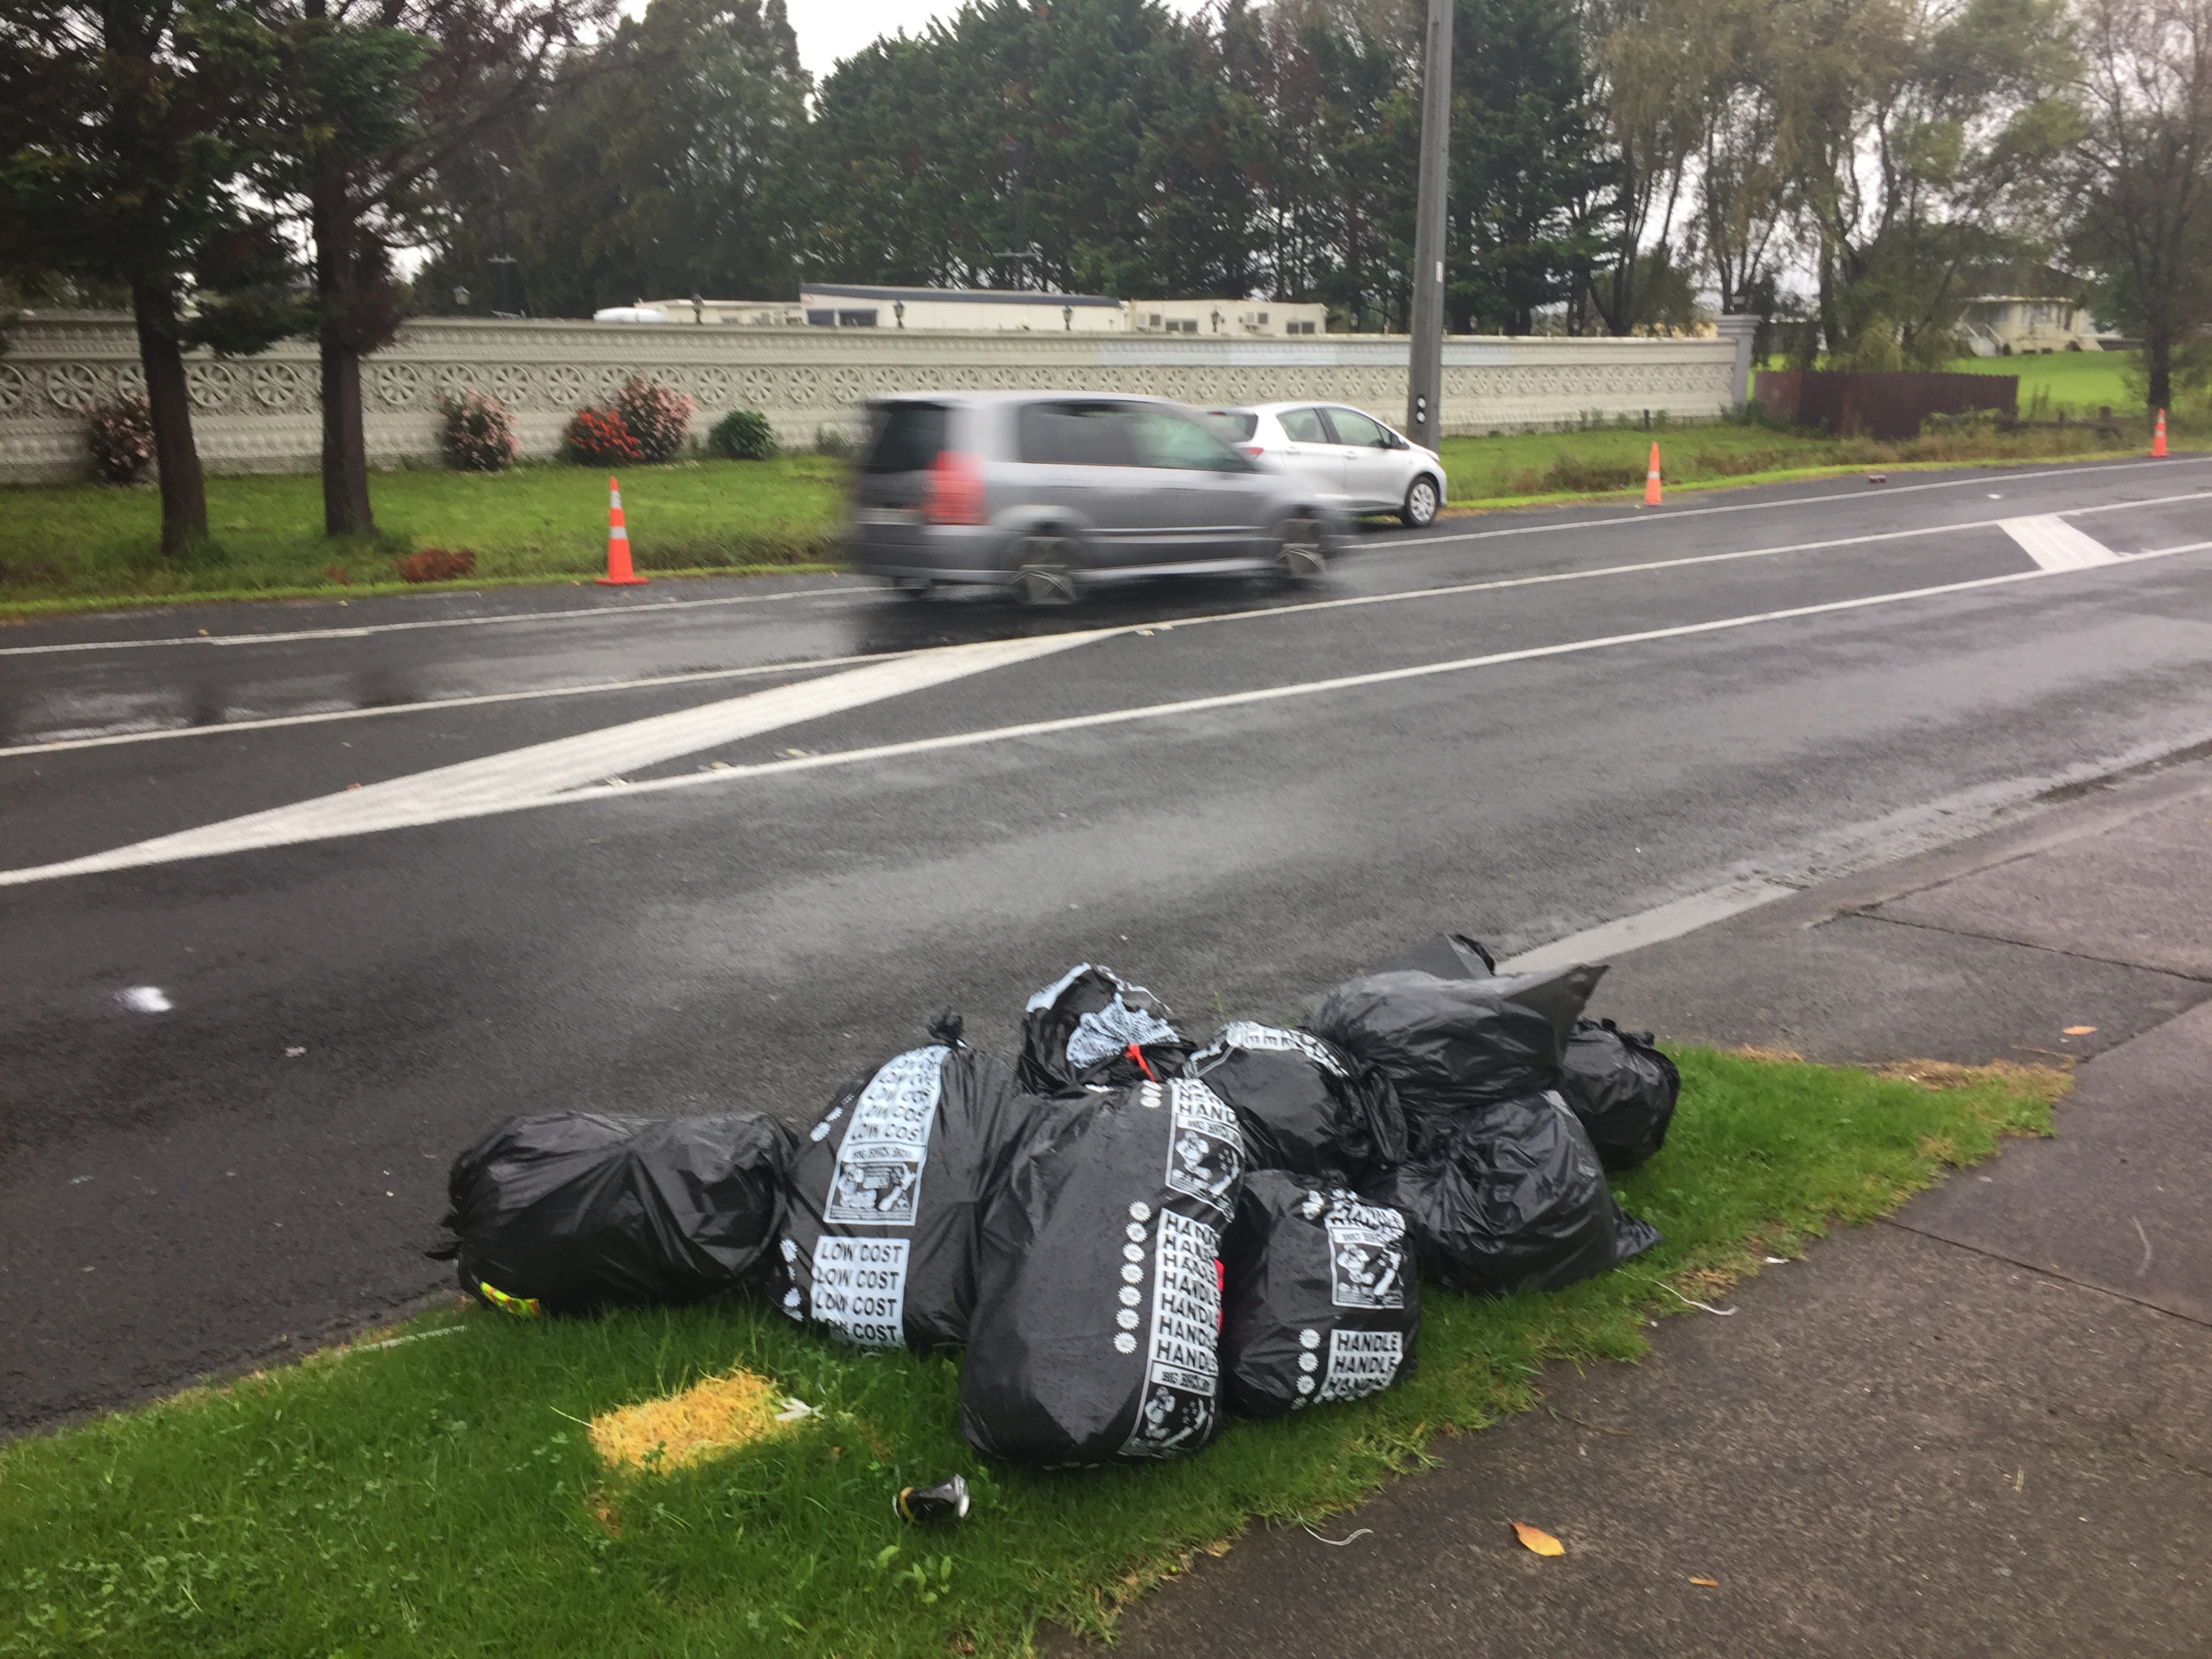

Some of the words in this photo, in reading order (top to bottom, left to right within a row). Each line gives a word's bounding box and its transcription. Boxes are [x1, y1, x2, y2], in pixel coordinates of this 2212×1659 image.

[821, 1242, 856, 1263] LOW
[860, 1244, 903, 1264] COST
[815, 1267, 853, 1288] LOW
[857, 1269, 900, 1290] COST
[815, 1290, 850, 1313] LOW
[853, 1296, 897, 1318] COST
[853, 1322, 898, 1343] COST
[1338, 1332, 1398, 1353] HANDLE
